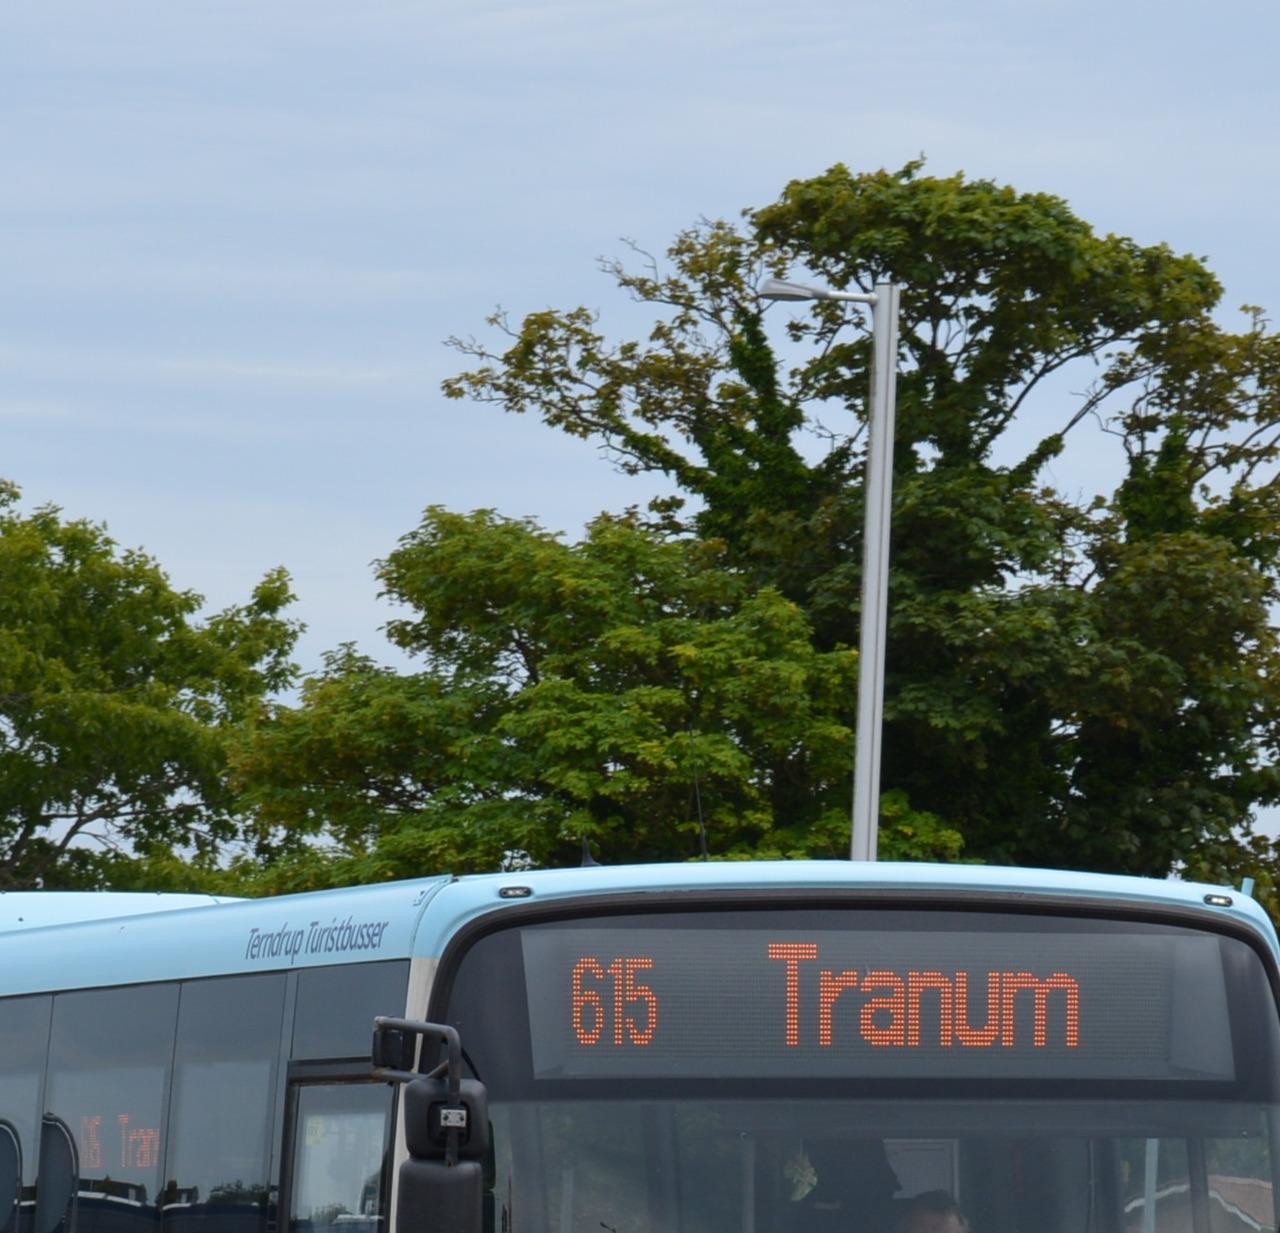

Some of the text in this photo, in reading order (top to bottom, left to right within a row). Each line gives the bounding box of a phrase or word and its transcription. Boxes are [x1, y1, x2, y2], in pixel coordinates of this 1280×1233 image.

[245, 915, 389, 965] Terndrup Turistbusser
[573, 942, 1079, 1046] 615 Tranum
